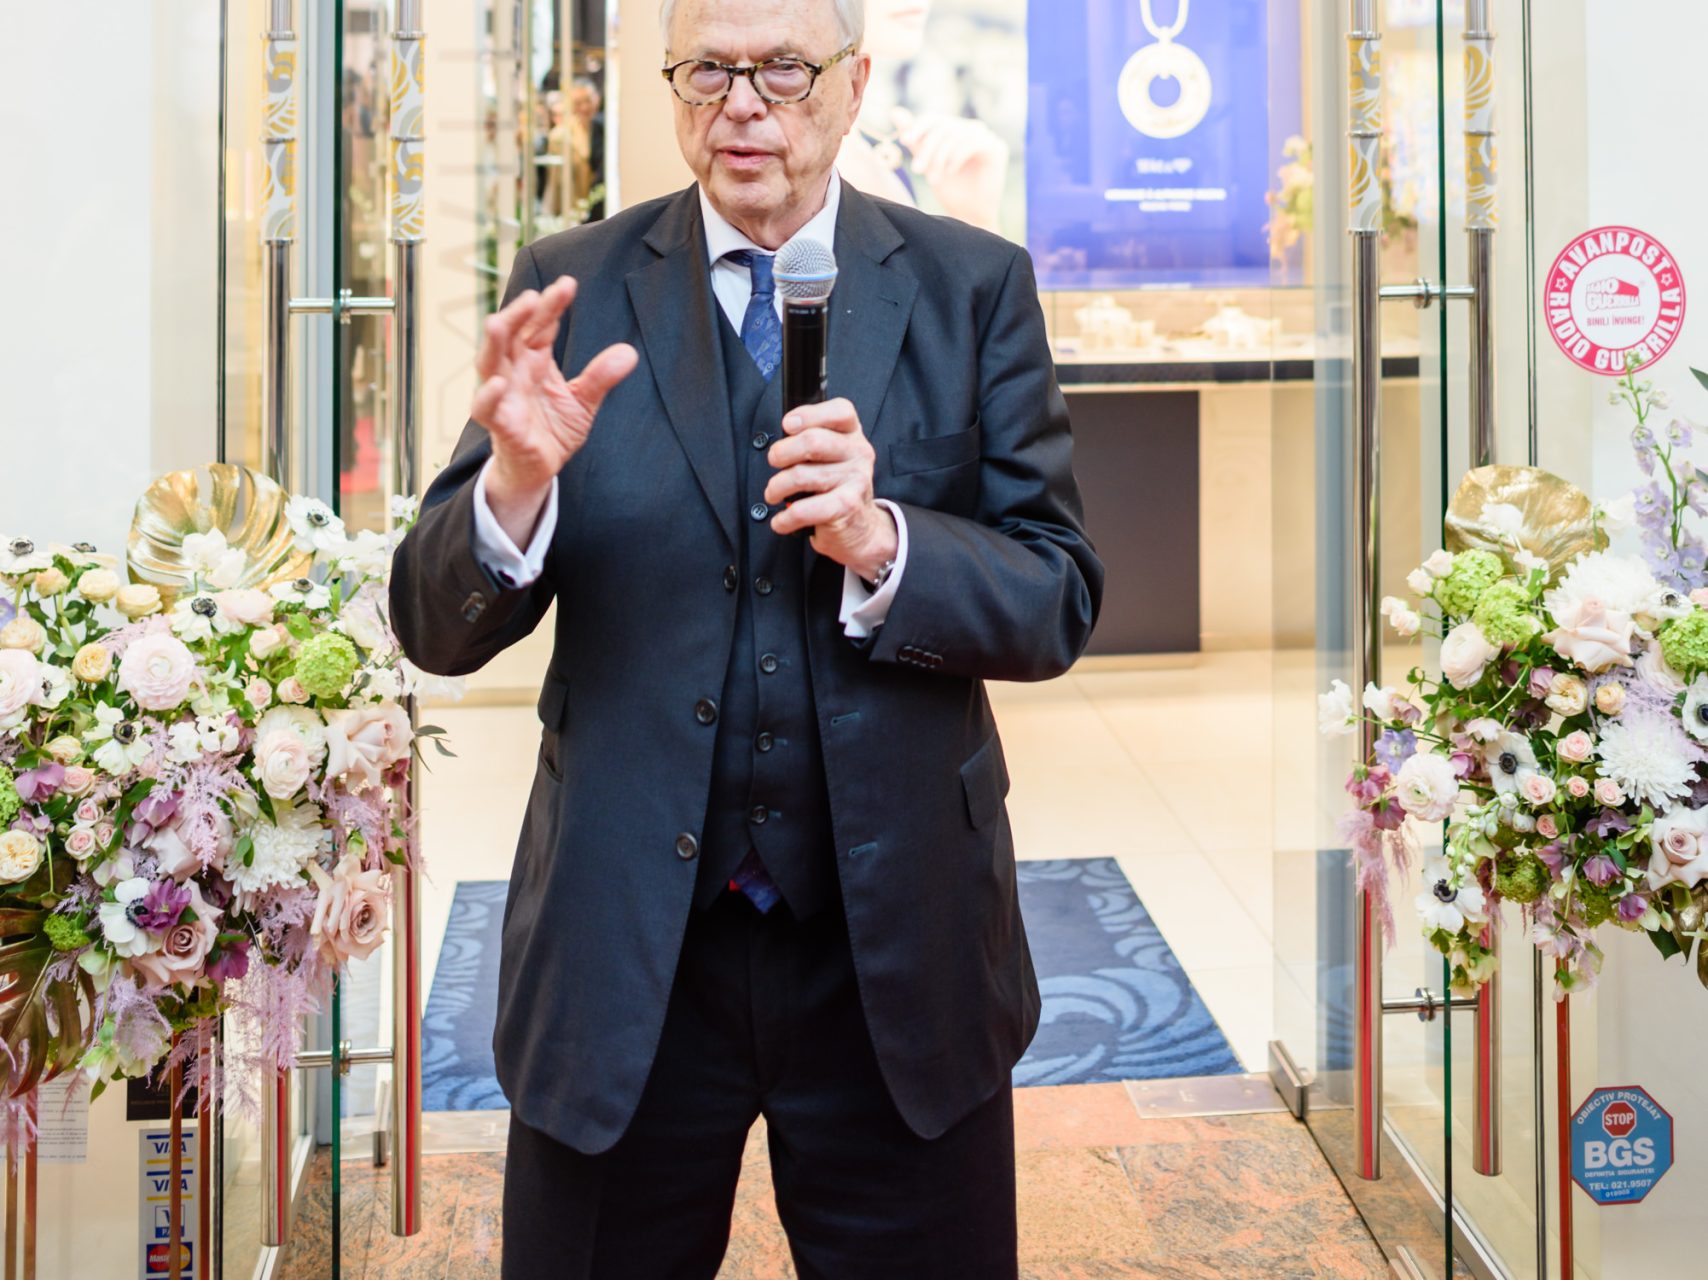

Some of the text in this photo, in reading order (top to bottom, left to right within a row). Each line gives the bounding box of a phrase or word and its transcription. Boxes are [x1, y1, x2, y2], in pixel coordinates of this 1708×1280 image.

[1559, 231, 1671, 280] AVANPOST
[1550, 292, 1591, 359] RADIO
[1577, 1092, 1661, 1124] OBIECTIV PROTEJAT
[1605, 1113, 1634, 1126] STOP
[153, 1141, 187, 1154] VIA
[1584, 1137, 1656, 1169] BGS
[153, 1178, 188, 1192] VIA
